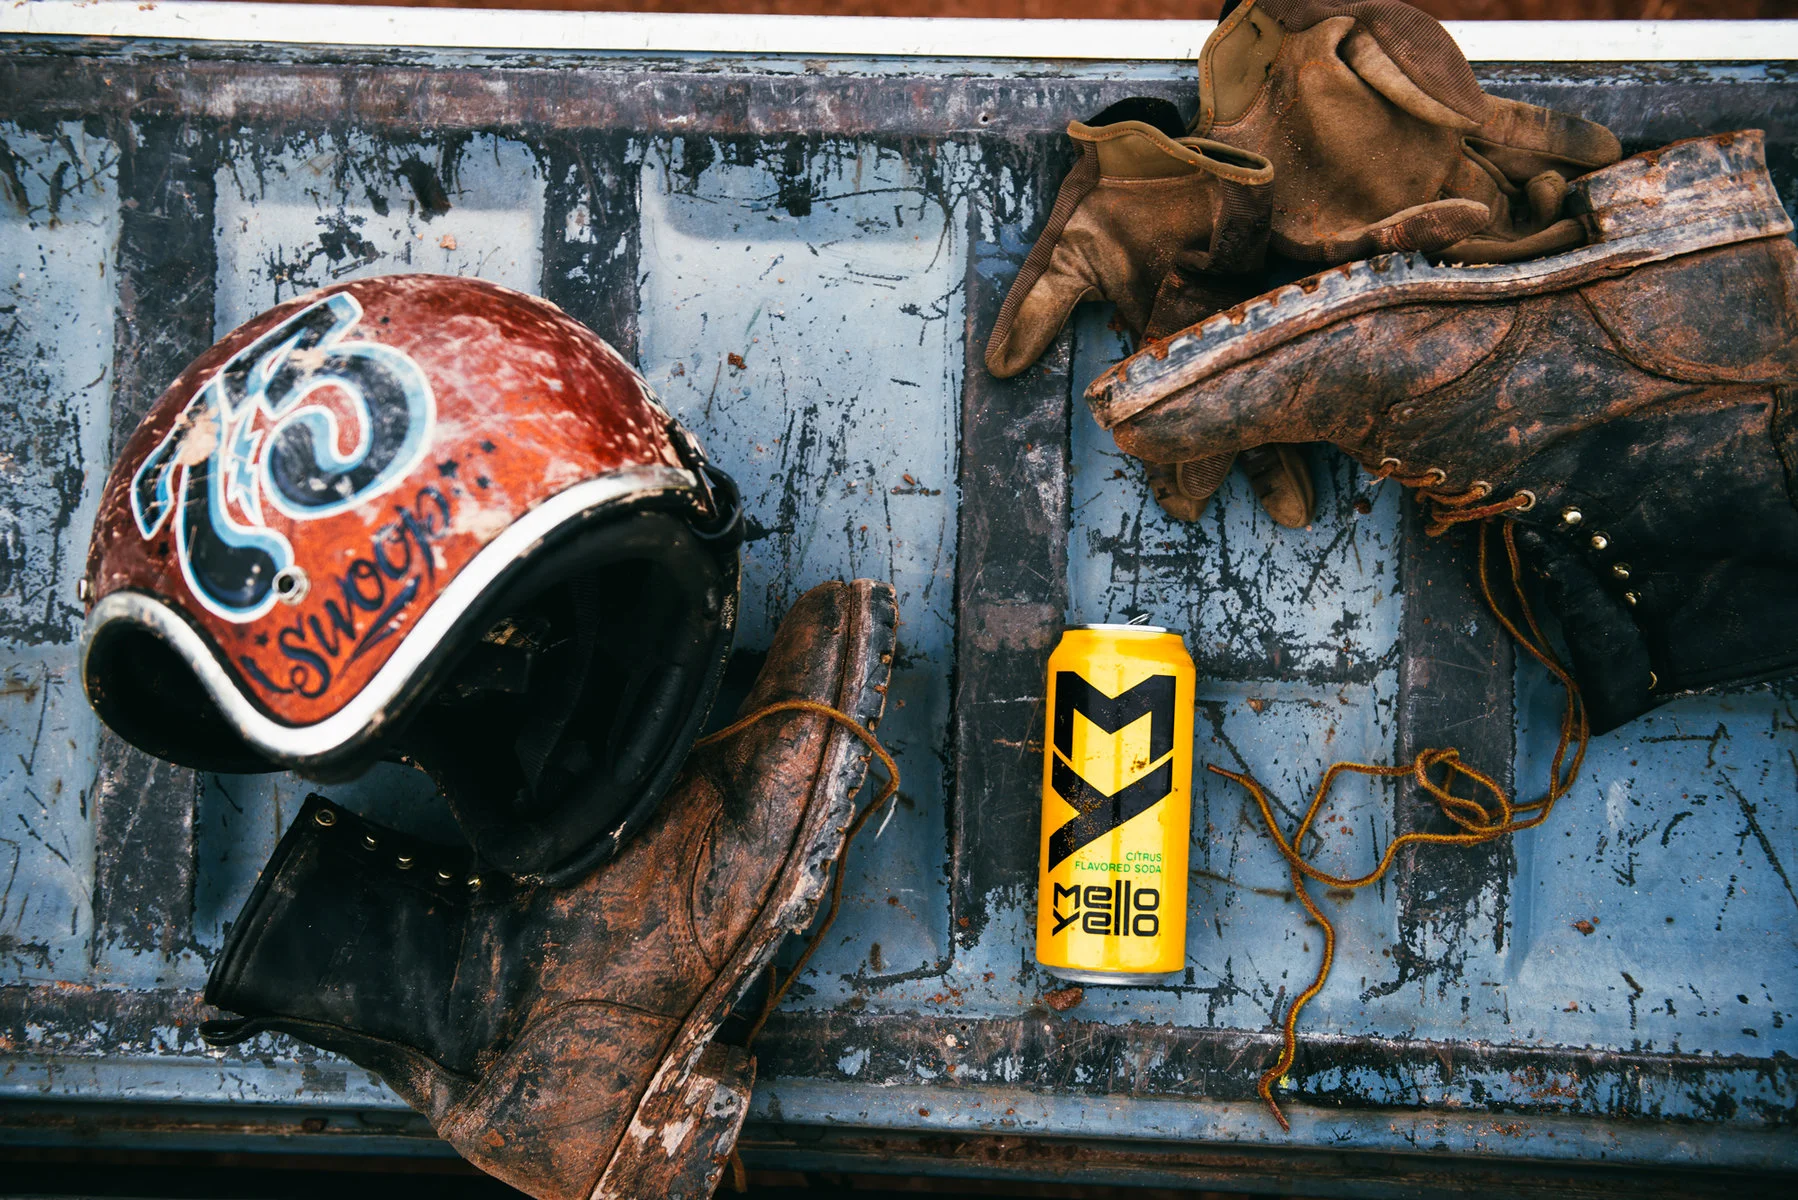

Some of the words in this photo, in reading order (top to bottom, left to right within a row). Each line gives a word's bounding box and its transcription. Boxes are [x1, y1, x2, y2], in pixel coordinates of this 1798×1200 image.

[1125, 851, 1162, 863] CITRUS
[1074, 860, 1131, 873] FLAVORED
[1134, 863, 1162, 874] SODA
[1053, 880, 1160, 912] Mello
